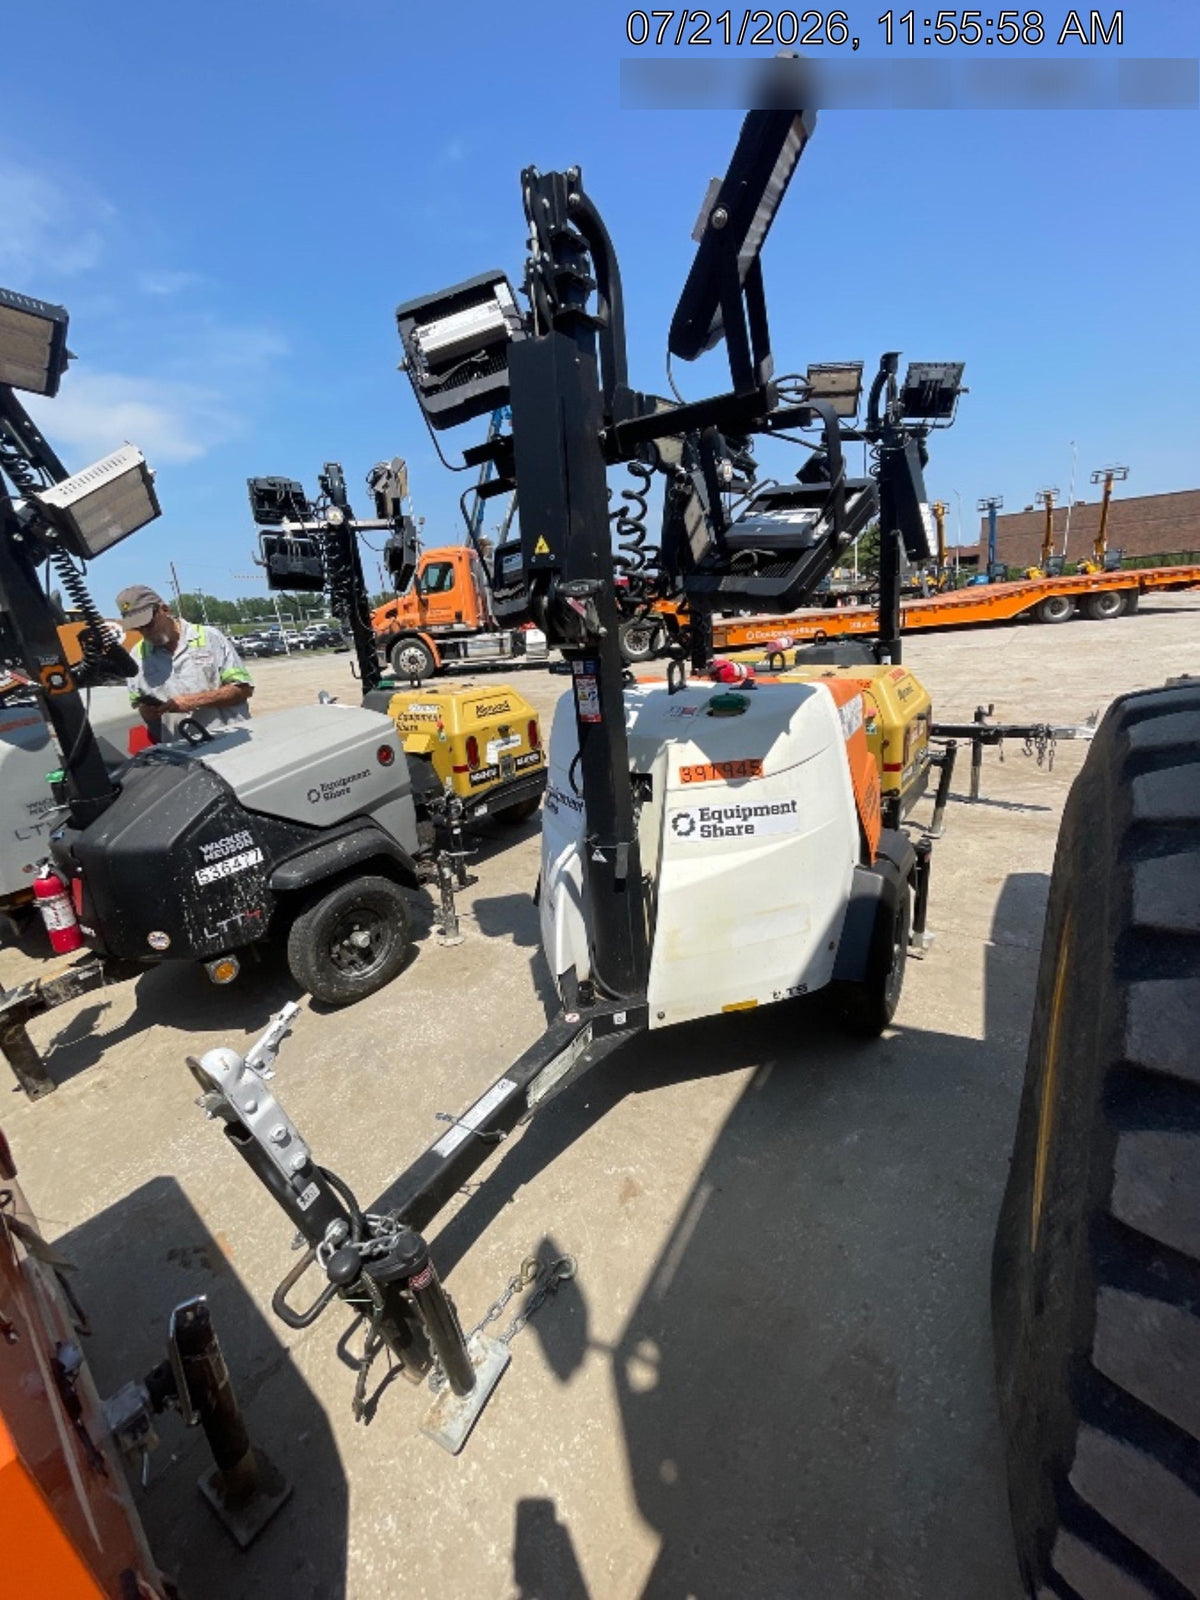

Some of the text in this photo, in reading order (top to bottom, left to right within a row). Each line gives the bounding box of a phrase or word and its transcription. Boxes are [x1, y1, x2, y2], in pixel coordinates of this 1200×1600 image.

[698, 799, 798, 823] Equipment
[198, 829, 251, 854] WACKER
[700, 823, 755, 838] Share
[202, 835, 255, 862] NEUSON
